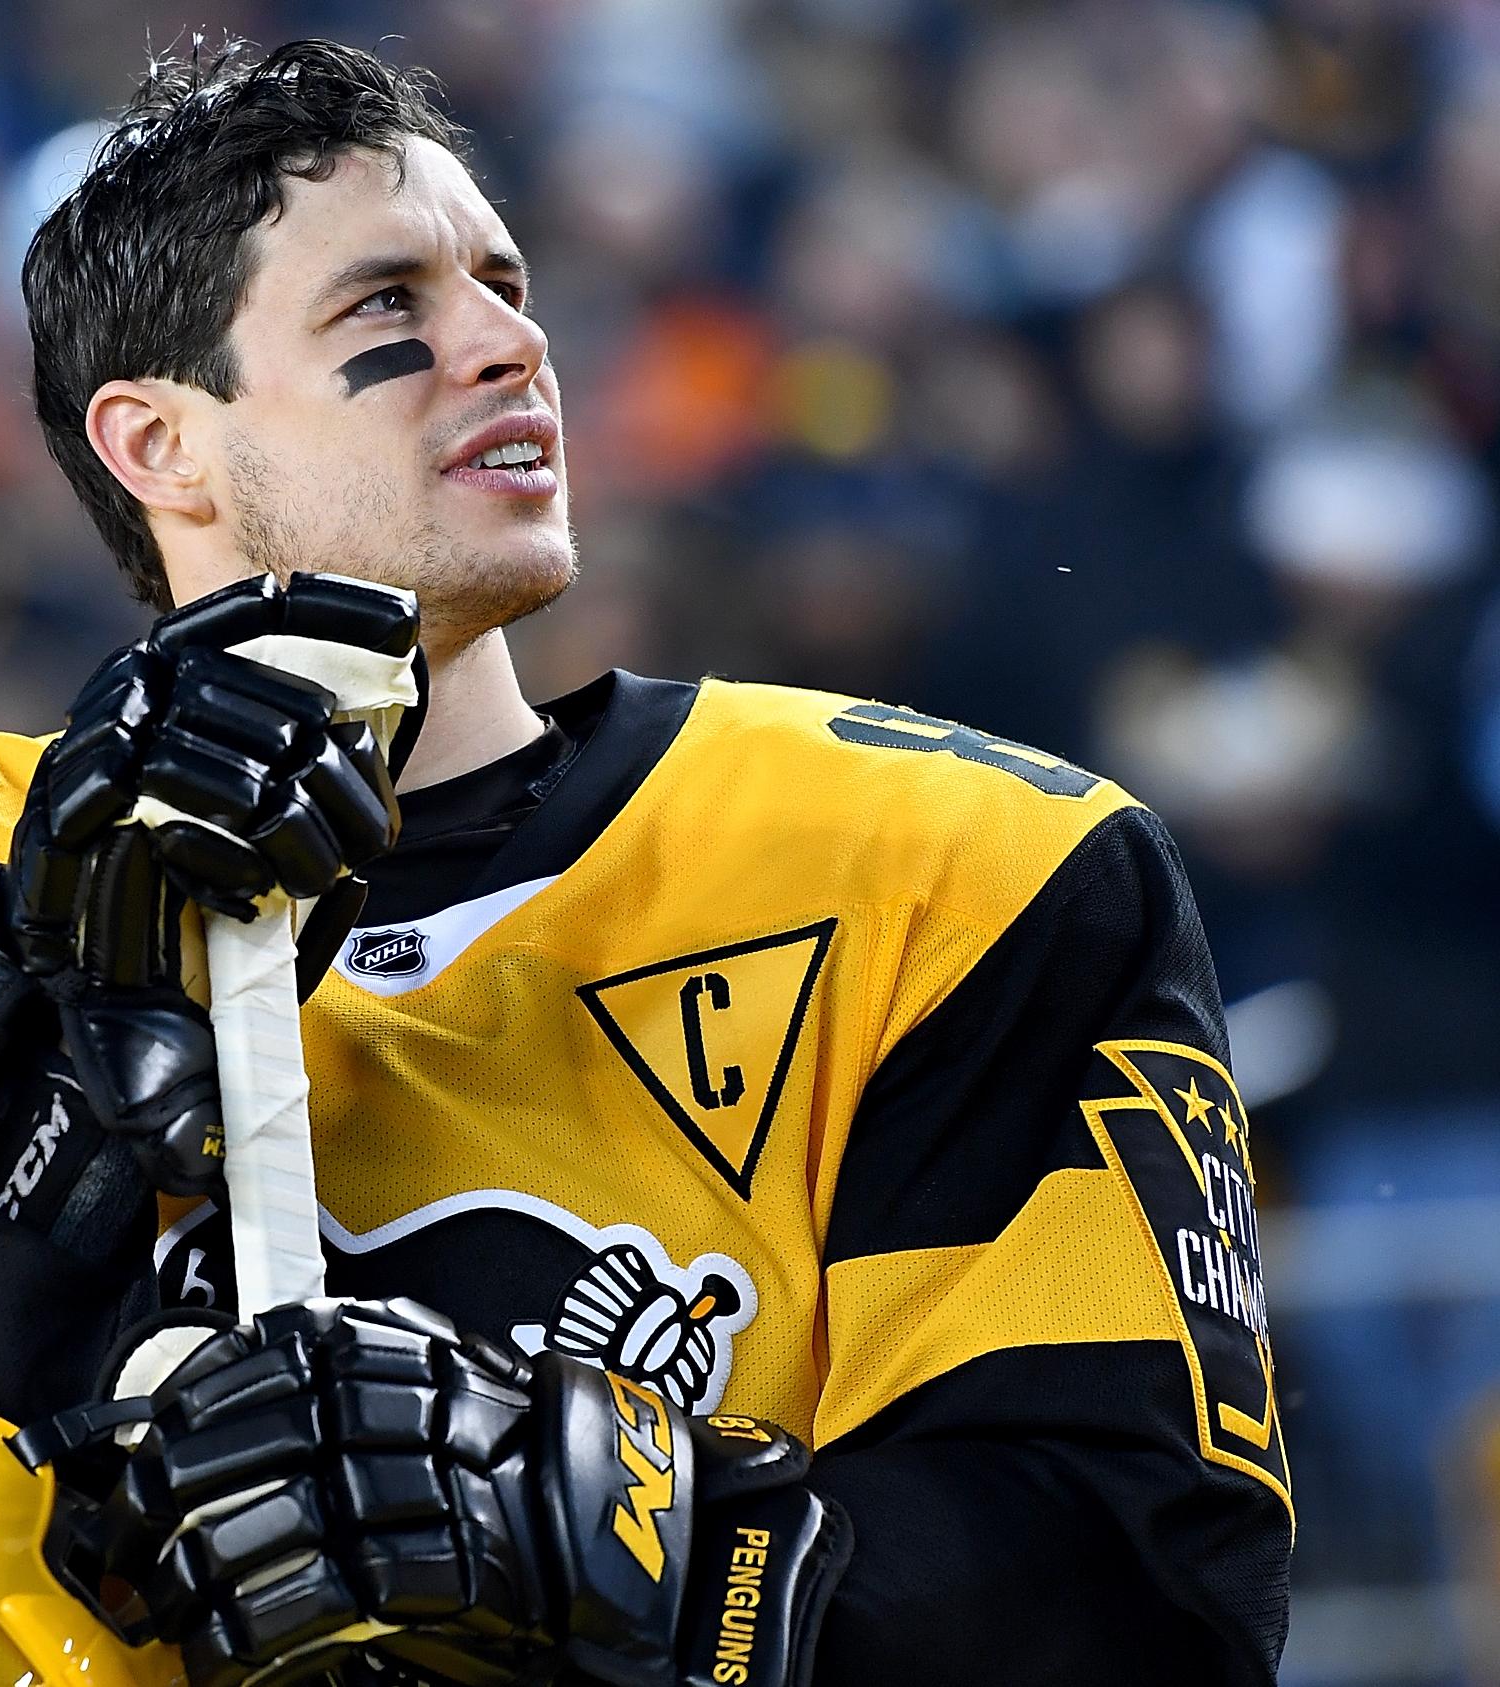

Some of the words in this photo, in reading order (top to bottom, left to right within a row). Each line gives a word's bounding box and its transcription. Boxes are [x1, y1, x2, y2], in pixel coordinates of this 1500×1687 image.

[365, 940, 414, 968] NHL
[679, 972, 745, 1110] C
[1202, 1151, 1257, 1260] CITY
[604, 1369, 674, 1584] CCM
[712, 1527, 771, 1687] PENGUINS
